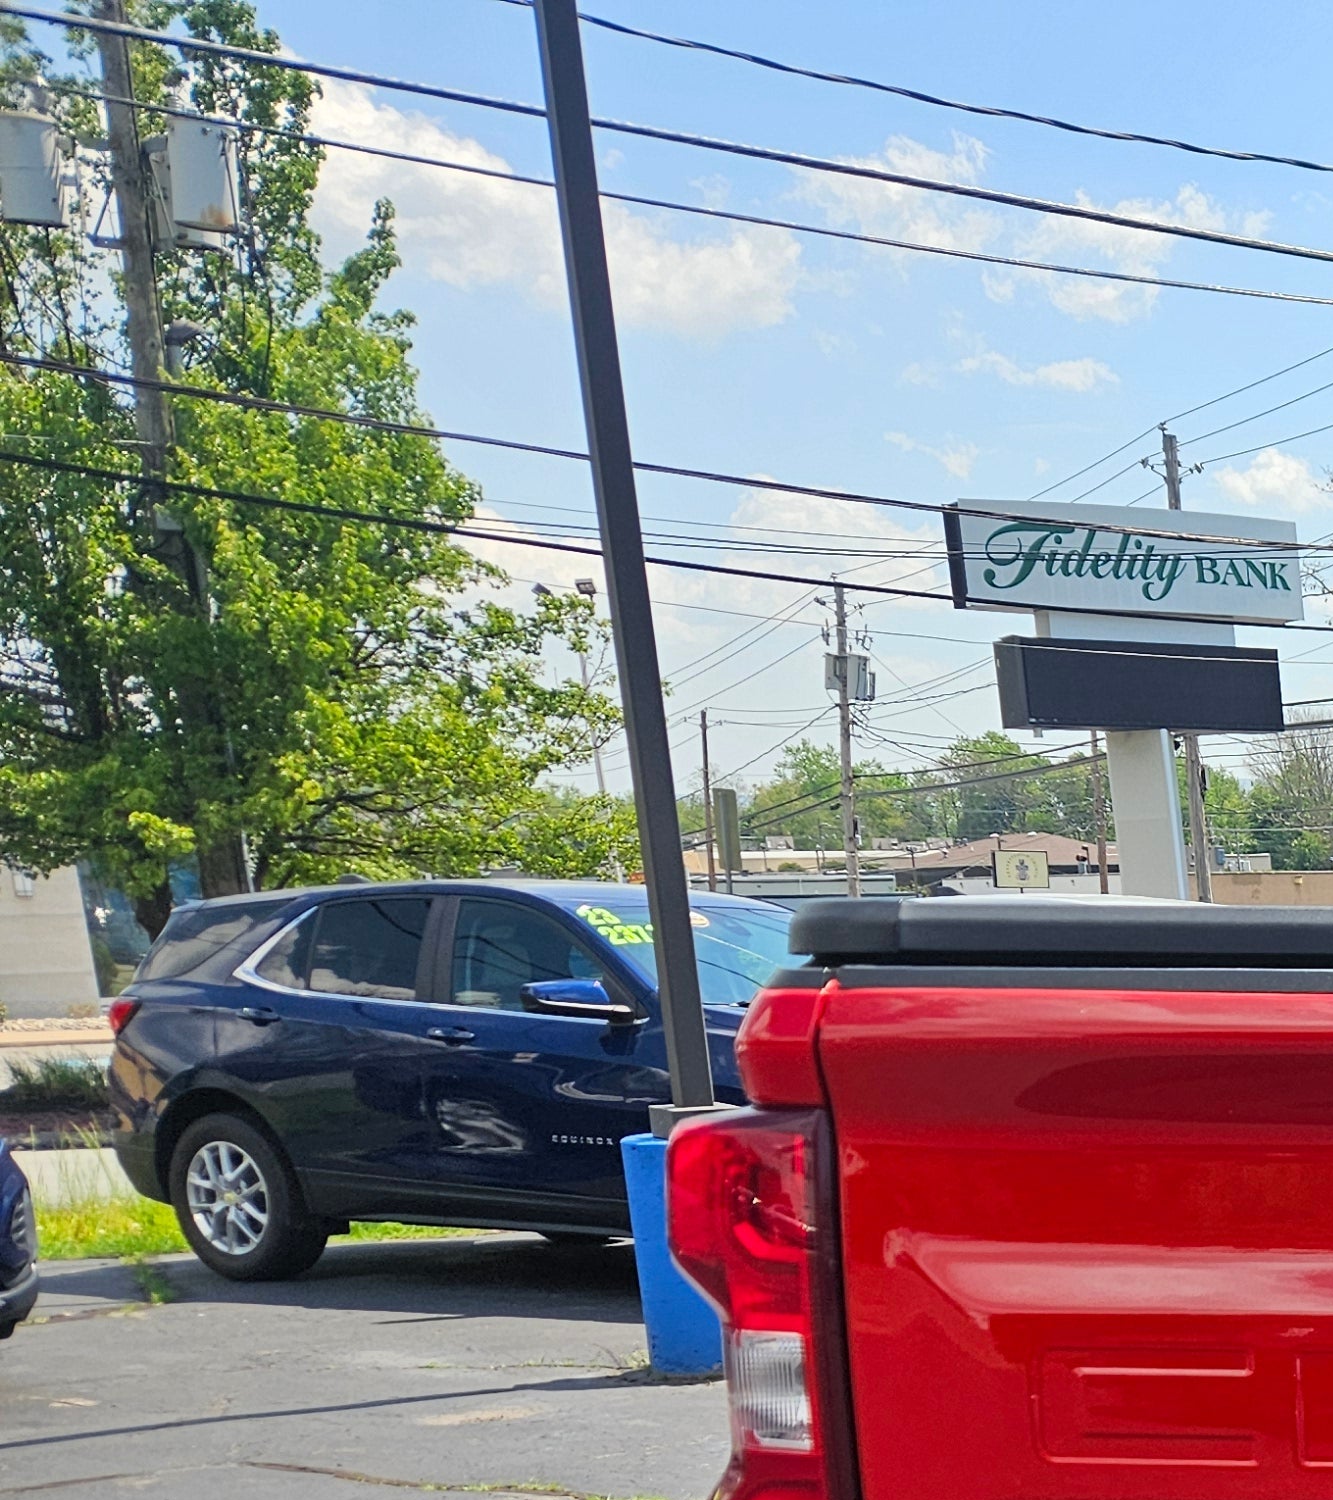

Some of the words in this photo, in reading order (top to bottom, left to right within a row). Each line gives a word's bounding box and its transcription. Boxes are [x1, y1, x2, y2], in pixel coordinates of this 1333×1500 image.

[983, 521, 1187, 601] Fidelity
[1194, 554, 1292, 591] BANK
[551, 1134, 614, 1146] EQUINOX
